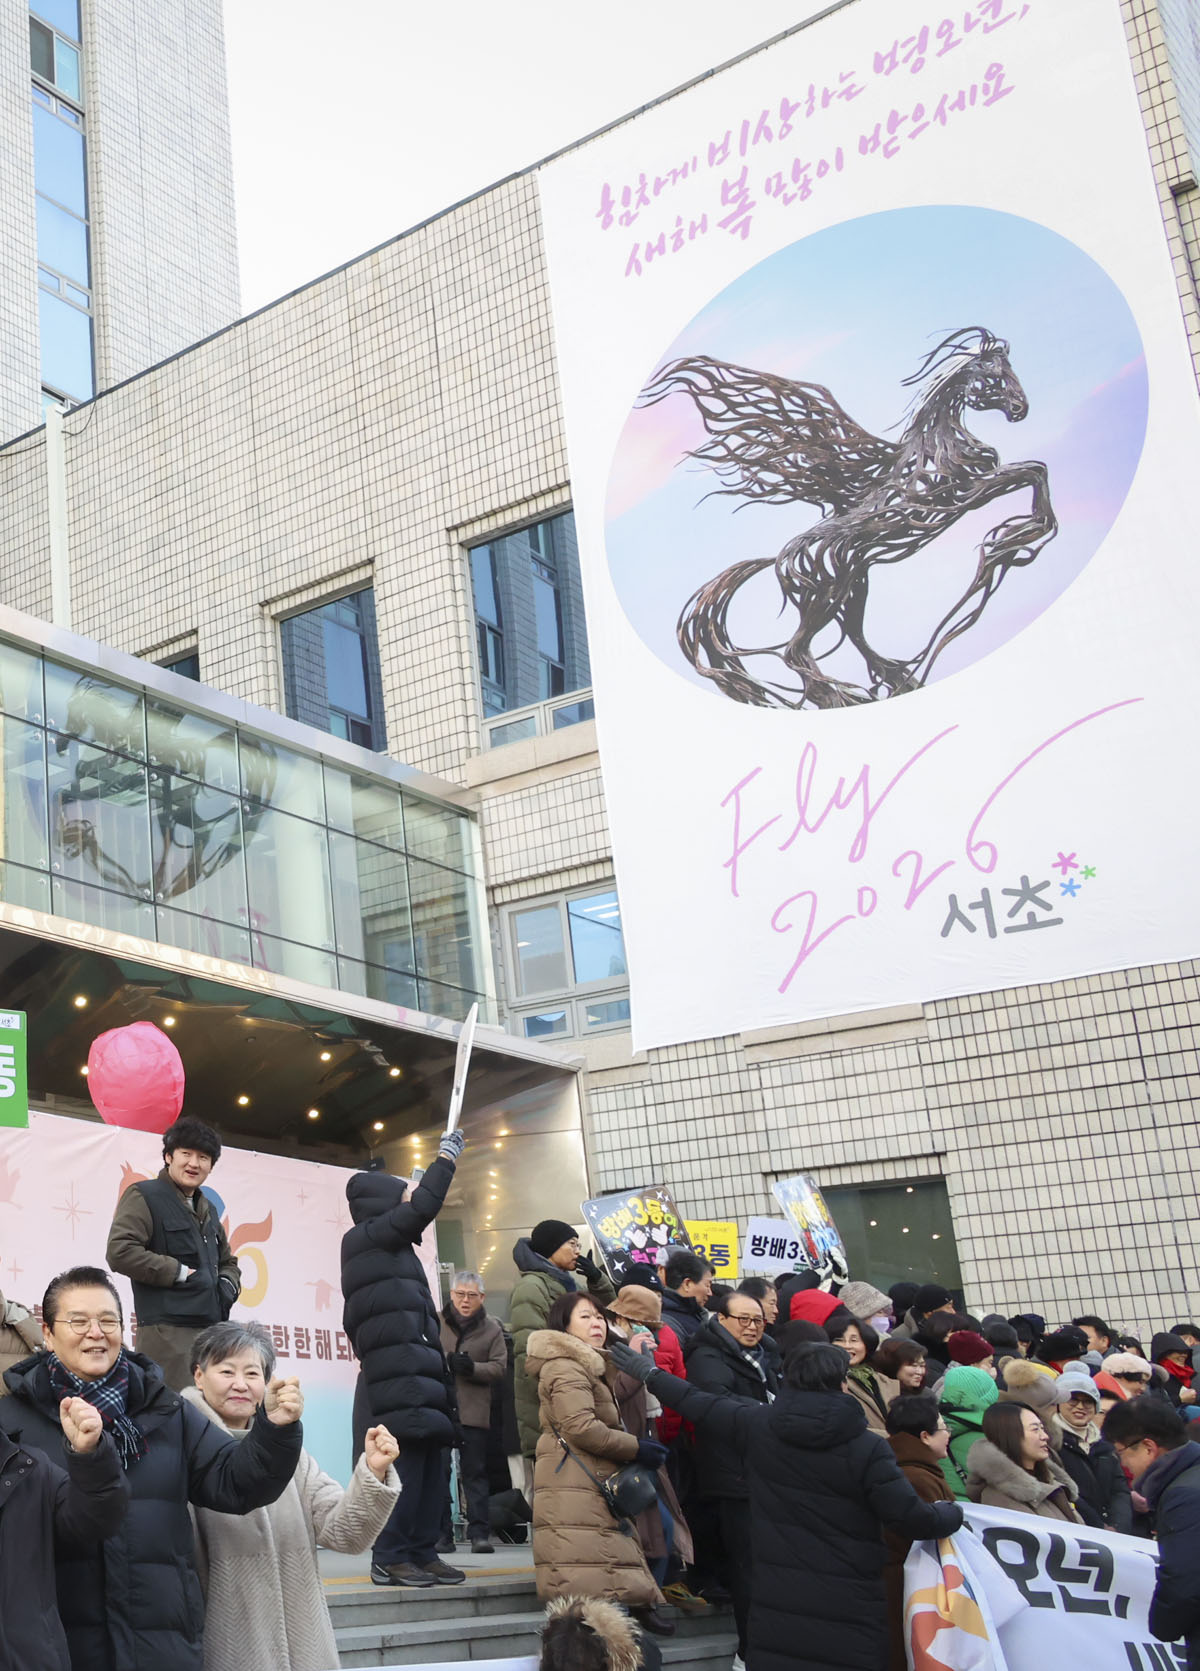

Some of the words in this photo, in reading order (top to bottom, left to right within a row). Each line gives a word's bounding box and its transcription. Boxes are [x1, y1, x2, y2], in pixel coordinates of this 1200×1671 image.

[596, 156, 698, 230] 힘차게
[707, 70, 866, 168] 비상하는
[625, 214, 708, 277] 새해
[717, 166, 756, 239] 복
[765, 147, 844, 206] 많이
[858, 63, 1016, 159] 받으세요
[720, 724, 959, 897] Fly
[771, 697, 1144, 994] 2026
[940, 875, 1064, 939] 서초
[294, 1326, 311, 1360] 한
[315, 1328, 332, 1361] 해
[335, 1331, 356, 1362] 되
[963, 1520, 1130, 1619] 오년,
